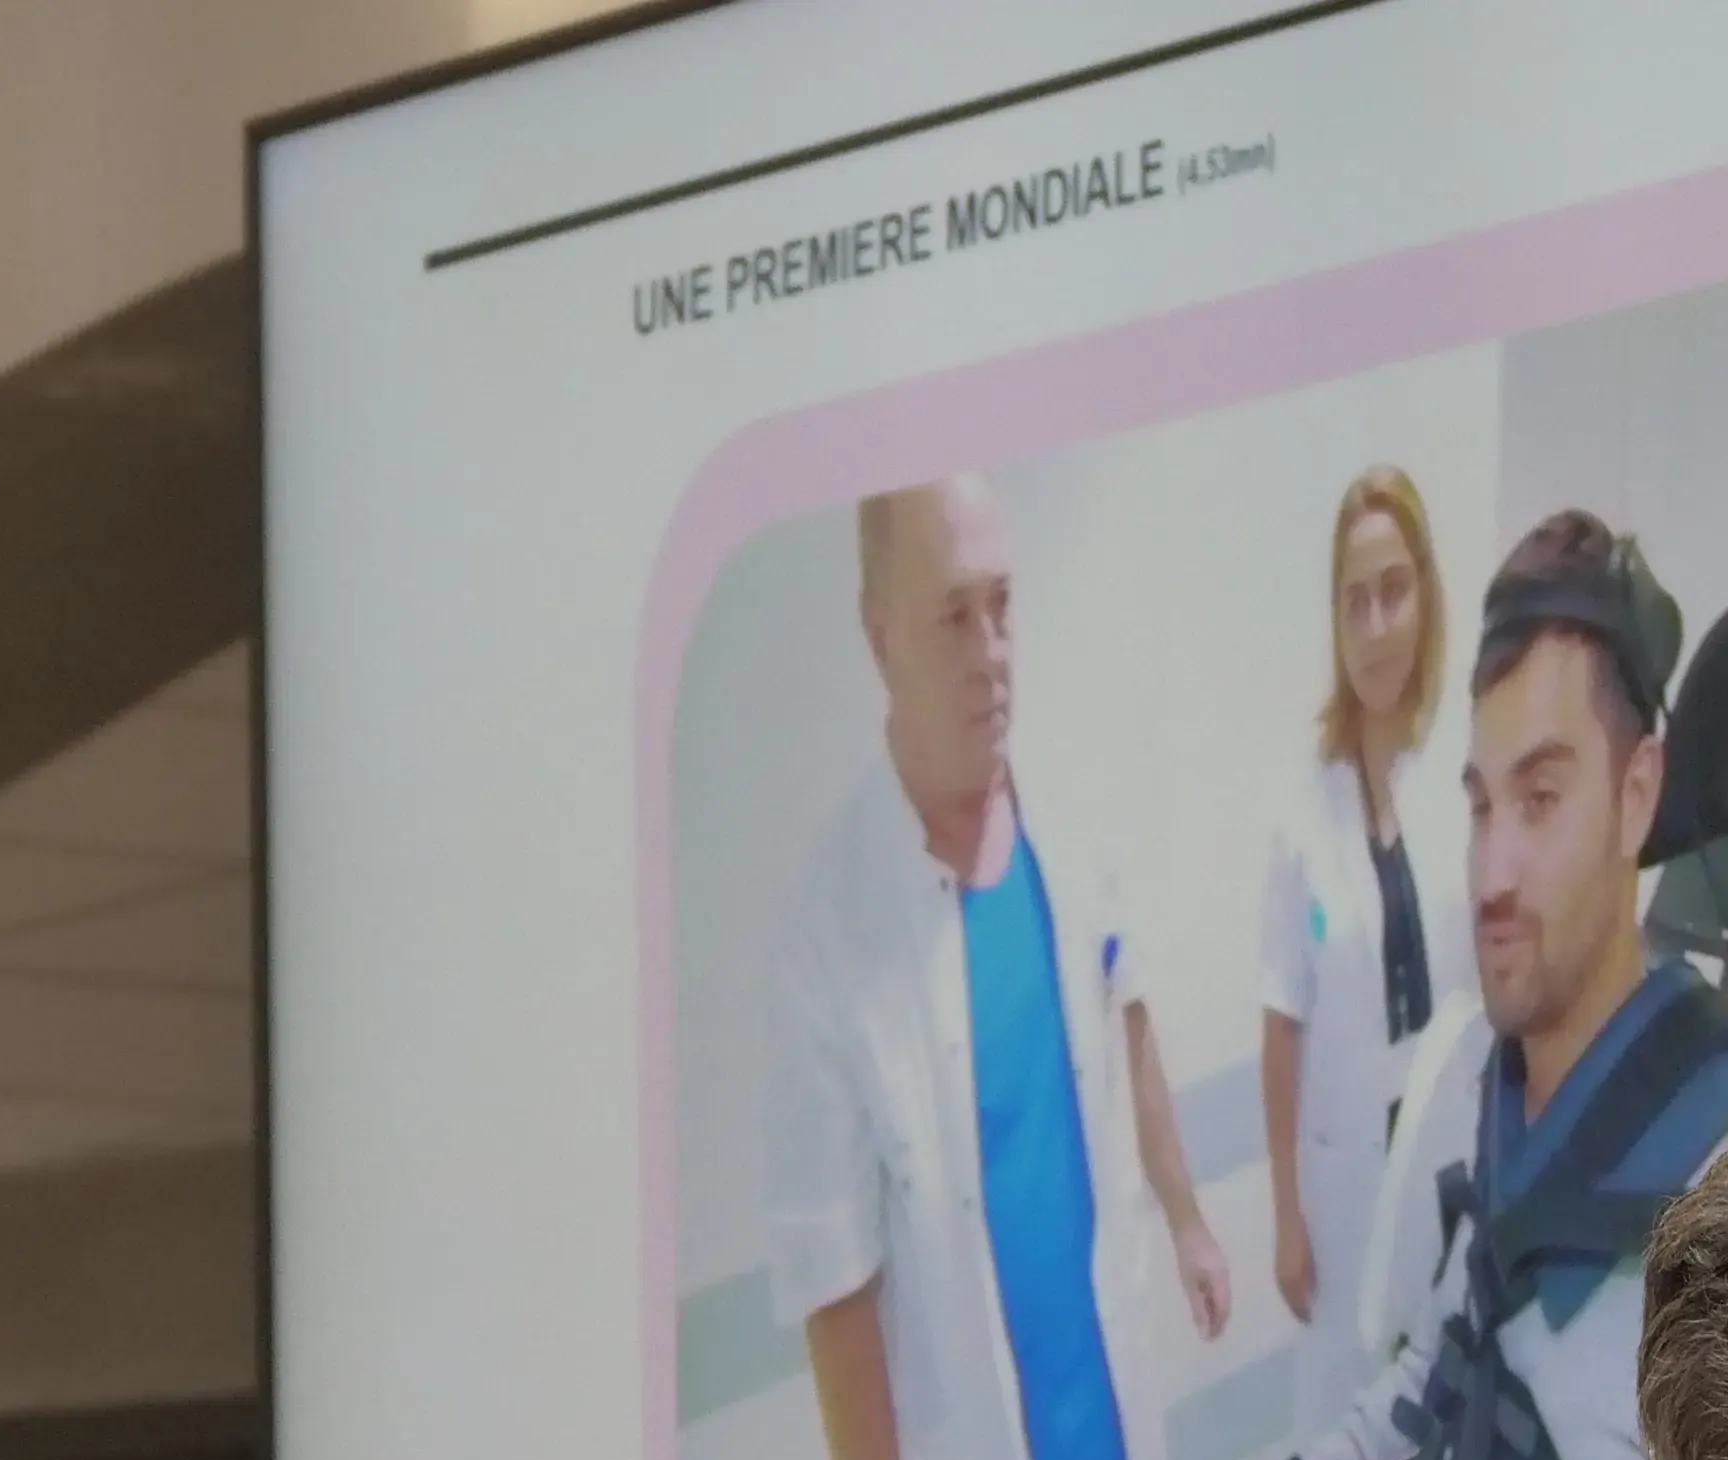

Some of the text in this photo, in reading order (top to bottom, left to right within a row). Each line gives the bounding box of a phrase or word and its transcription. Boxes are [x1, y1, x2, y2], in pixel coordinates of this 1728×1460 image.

[632, 264, 714, 336] UNE
[725, 203, 933, 312] PREMIERE
[946, 138, 1165, 253] MONDIALE
